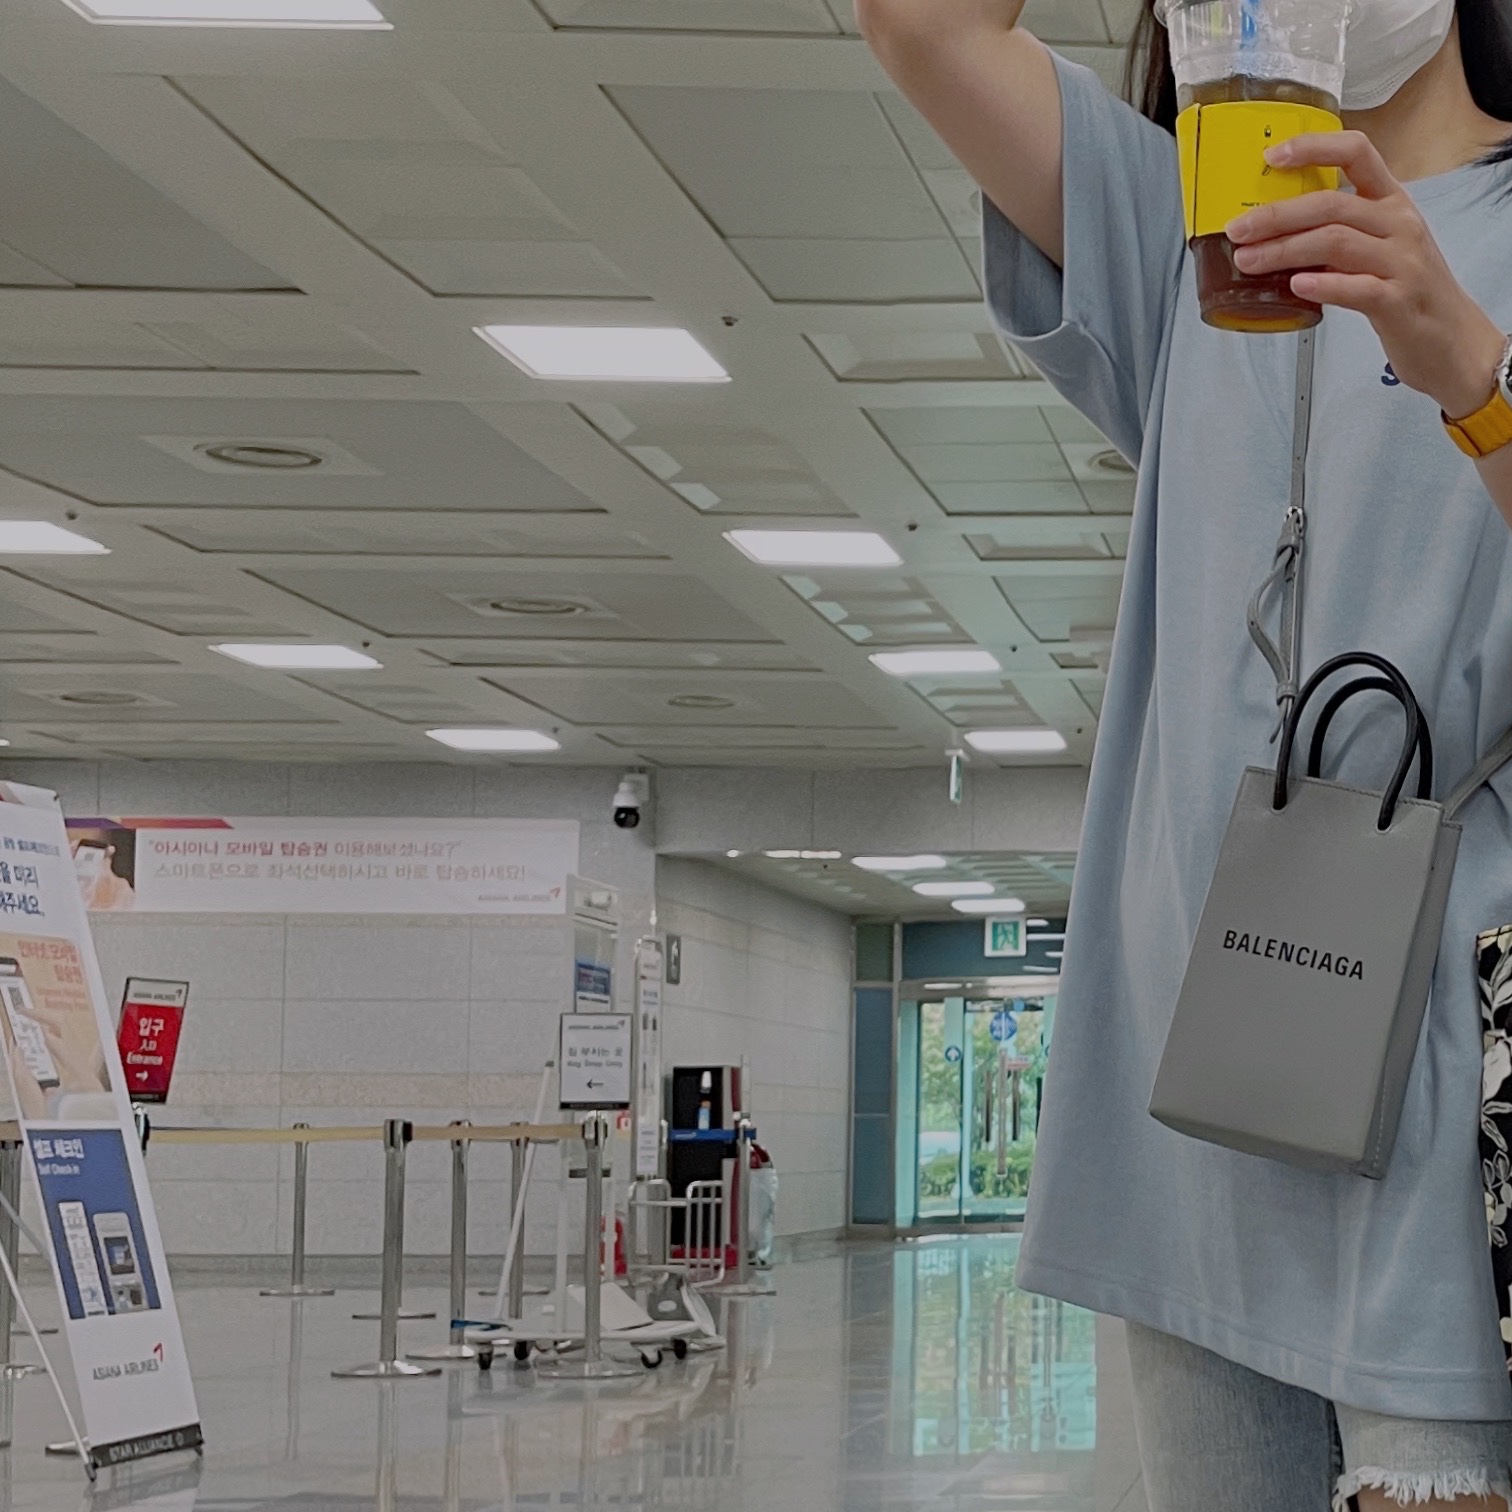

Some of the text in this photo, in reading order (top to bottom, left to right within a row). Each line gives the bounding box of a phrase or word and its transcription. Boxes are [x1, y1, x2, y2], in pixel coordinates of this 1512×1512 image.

[226, 841, 274, 856] 모바일
[1222, 929, 1364, 980] BALENCIAGA
[139, 1017, 164, 1037] 입구
